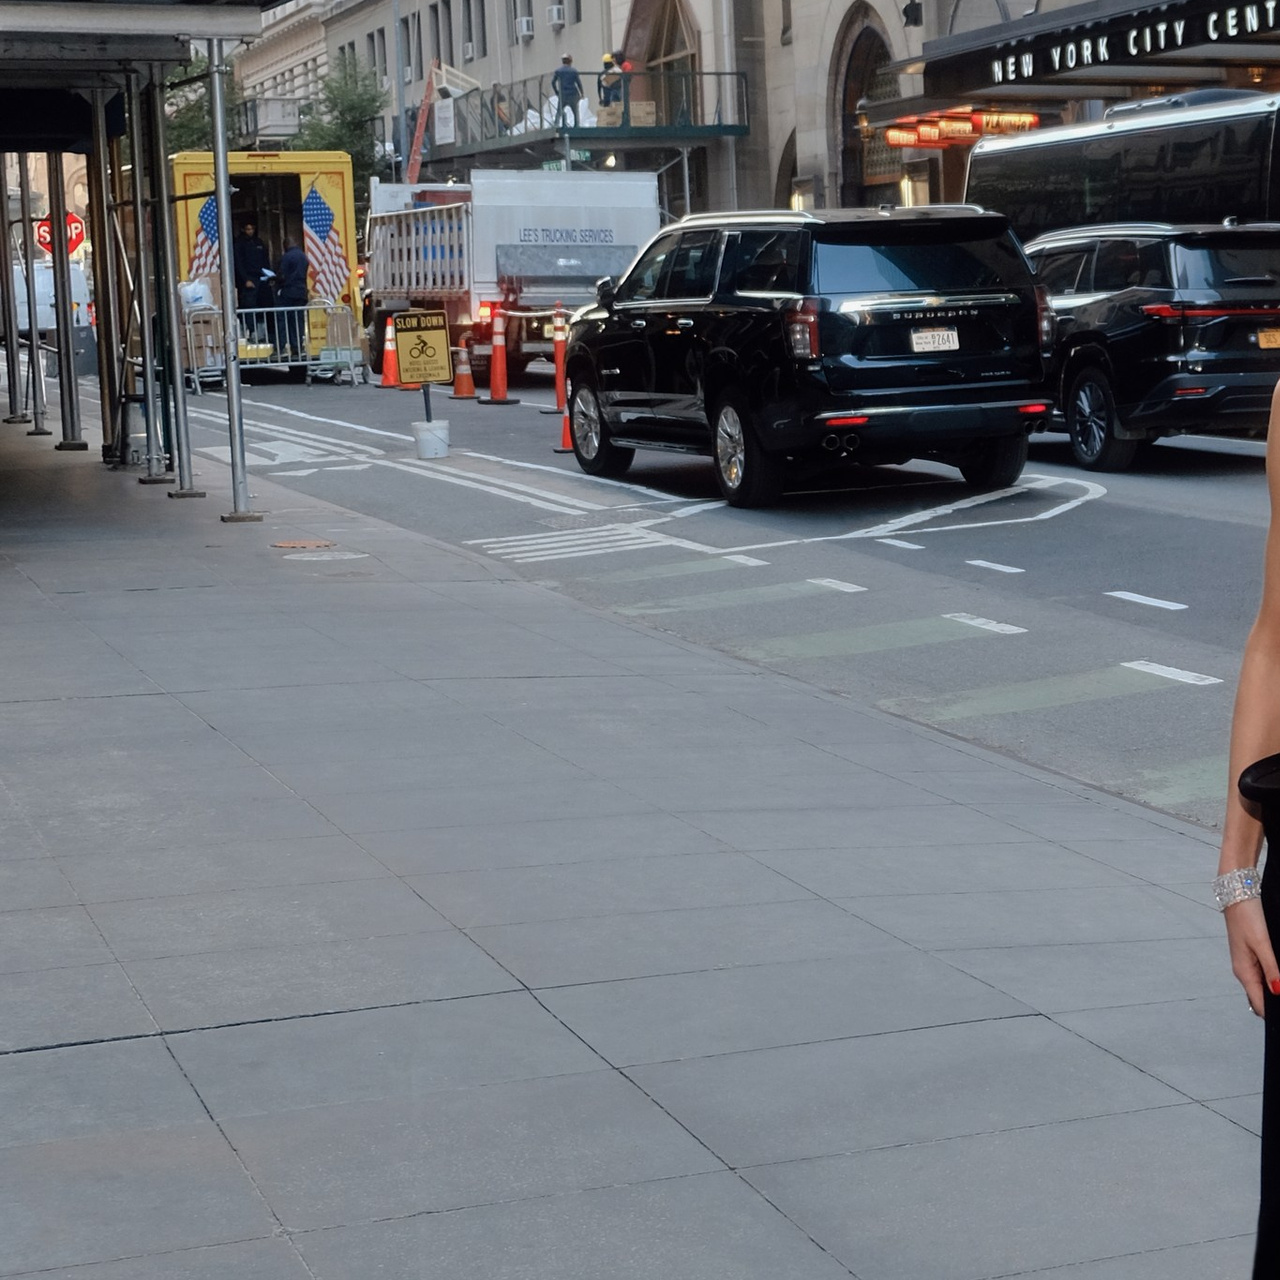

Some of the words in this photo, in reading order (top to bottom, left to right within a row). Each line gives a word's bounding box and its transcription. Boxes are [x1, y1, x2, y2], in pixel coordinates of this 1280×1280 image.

[991, 52, 1034, 84] NEW
[1050, 36, 1110, 71] YORK
[1127, 20, 1186, 56] CITY
[39, 222, 82, 244] SP
[519, 228, 539, 243] LEE'S
[541, 229, 577, 243] TRUCKING
[579, 229, 614, 243] SERVICES
[893, 309, 978, 319] SUBURBAN
[396, 317, 418, 329] SLOW
[421, 316, 444, 327] DOWN
[937, 333, 956, 346] 2641
